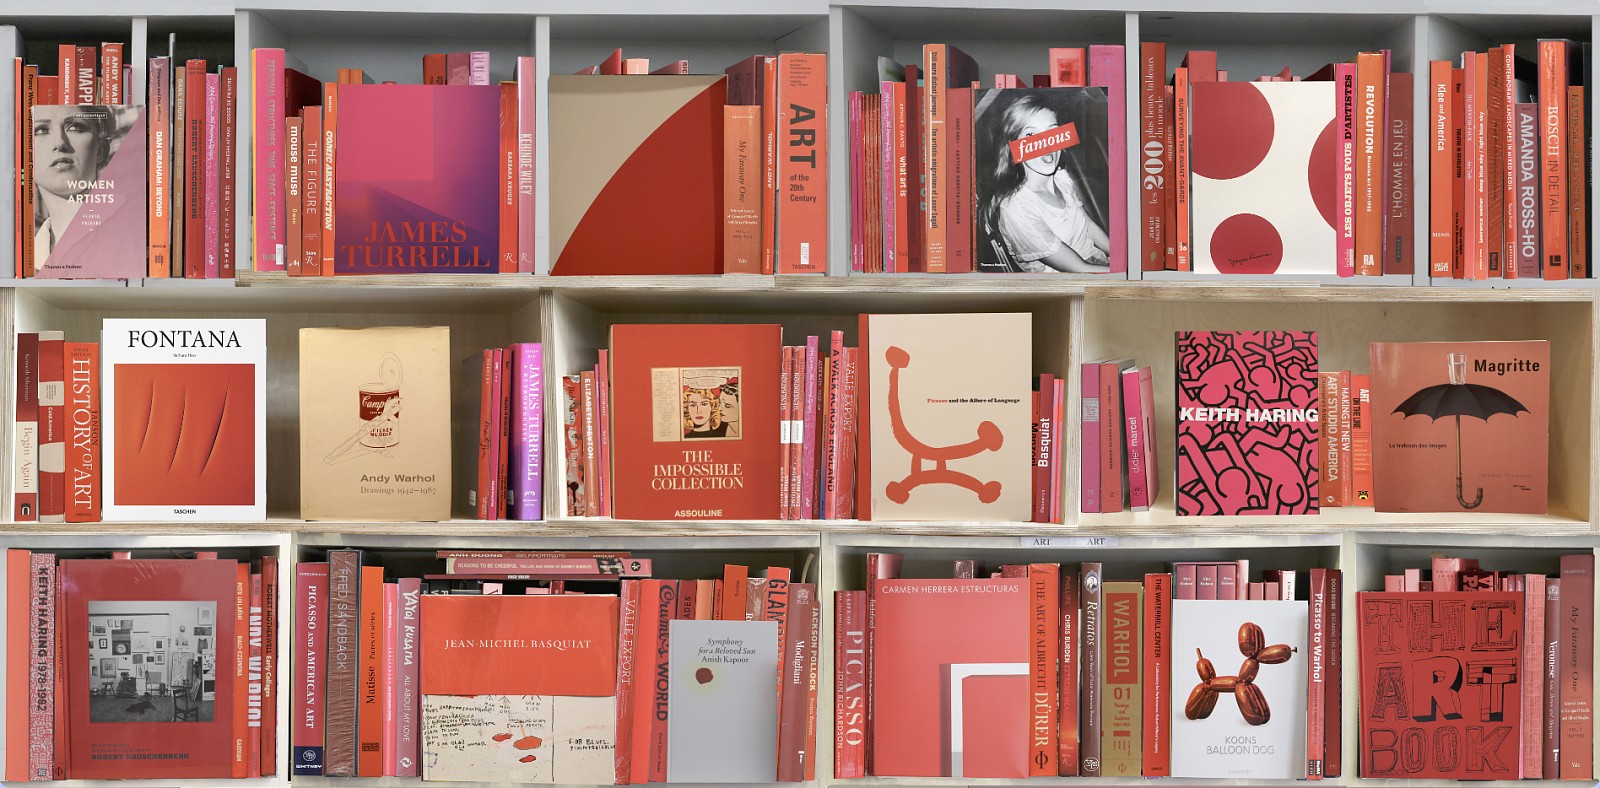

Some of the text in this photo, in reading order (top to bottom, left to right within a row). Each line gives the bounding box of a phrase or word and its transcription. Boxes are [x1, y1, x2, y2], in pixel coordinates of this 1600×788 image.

[1437, 84, 1447, 102] Klee
[790, 103, 816, 168] ART
[1366, 85, 1374, 153] REVOLUTION
[1437, 114, 1447, 150] America
[290, 126, 298, 196] mouse muse
[520, 134, 532, 194] KEHINDE WILEY
[1017, 131, 1071, 161] famous
[1344, 74, 1352, 238] LES OBJETS FOUS D'ARTISTES
[1548, 106, 1559, 216] BOSCH IN DETAIL
[307, 141, 317, 214] THE FIGURE
[325, 130, 333, 230] COMIC ABSTRACTION
[738, 141, 746, 202] My Faraway One
[1144, 140, 1164, 190] 200
[67, 180, 115, 190] WOMEN
[67, 194, 115, 204] ARTISTS
[790, 194, 817, 203] Century
[1520, 112, 1535, 257] AMANDA ROSS-HO
[364, 221, 468, 243] JAMES
[342, 245, 491, 269] TURRELL
[128, 330, 242, 348] FONTANA
[1474, 358, 1540, 376] Magritte
[830, 393, 838, 434] ACROSS
[1341, 388, 1350, 419] MAKING
[1353, 398, 1360, 406] ON
[1360, 388, 1370, 403] ART
[527, 364, 540, 480] JAMES TURRELL
[1180, 407, 1318, 422] KEITH HARING
[1328, 376, 1338, 481] ART STUDIO AMERICA
[73, 358, 92, 509] HISTORY OF ART
[1038, 418, 1050, 467] Basquiat
[1341, 429, 1350, 451] NEW
[654, 464, 742, 476] IMPOSSIBLE
[682, 450, 712, 462] THE
[828, 439, 836, 491] ENGLAND
[360, 474, 435, 484] Andy Warhol
[652, 477, 744, 490] COLLECTION
[403, 590, 418, 620] YAYOI
[882, 584, 1018, 594] CARMEN HERRERA ESTRUCTURAS
[307, 585, 316, 630] PICASSO
[337, 569, 348, 670] FRED SANDBACK
[1086, 601, 1098, 646] Retratos
[1314, 593, 1323, 628] Picasso
[37, 567, 48, 712] KEITH HARING 1978-1982
[444, 640, 592, 650] JEAN-MICHEL BASQUIAT
[707, 638, 743, 646] Symphony
[1114, 600, 1130, 677] WARHOL
[1314, 632, 1322, 642] to
[1364, 598, 1518, 656] THE
[698, 647, 709, 656] for
[724, 656, 748, 664] Kapoor
[793, 640, 804, 684] Modigliani
[1035, 580, 1050, 747] THE ART OF ALBRECHT DÜRER
[1314, 645, 1322, 682] Warhol
[1548, 640, 1558, 678] Veronese
[306, 650, 315, 704] AMERICAN
[846, 631, 863, 746] PICASSO
[1114, 687, 1130, 700] 01
[1369, 656, 1518, 723] ART
[306, 708, 314, 728] ART
[404, 713, 410, 723] MY
[1206, 746, 1274, 754] BALLOON DOG
[1224, 736, 1256, 744] KOONS
[1369, 726, 1513, 774] BOOK
